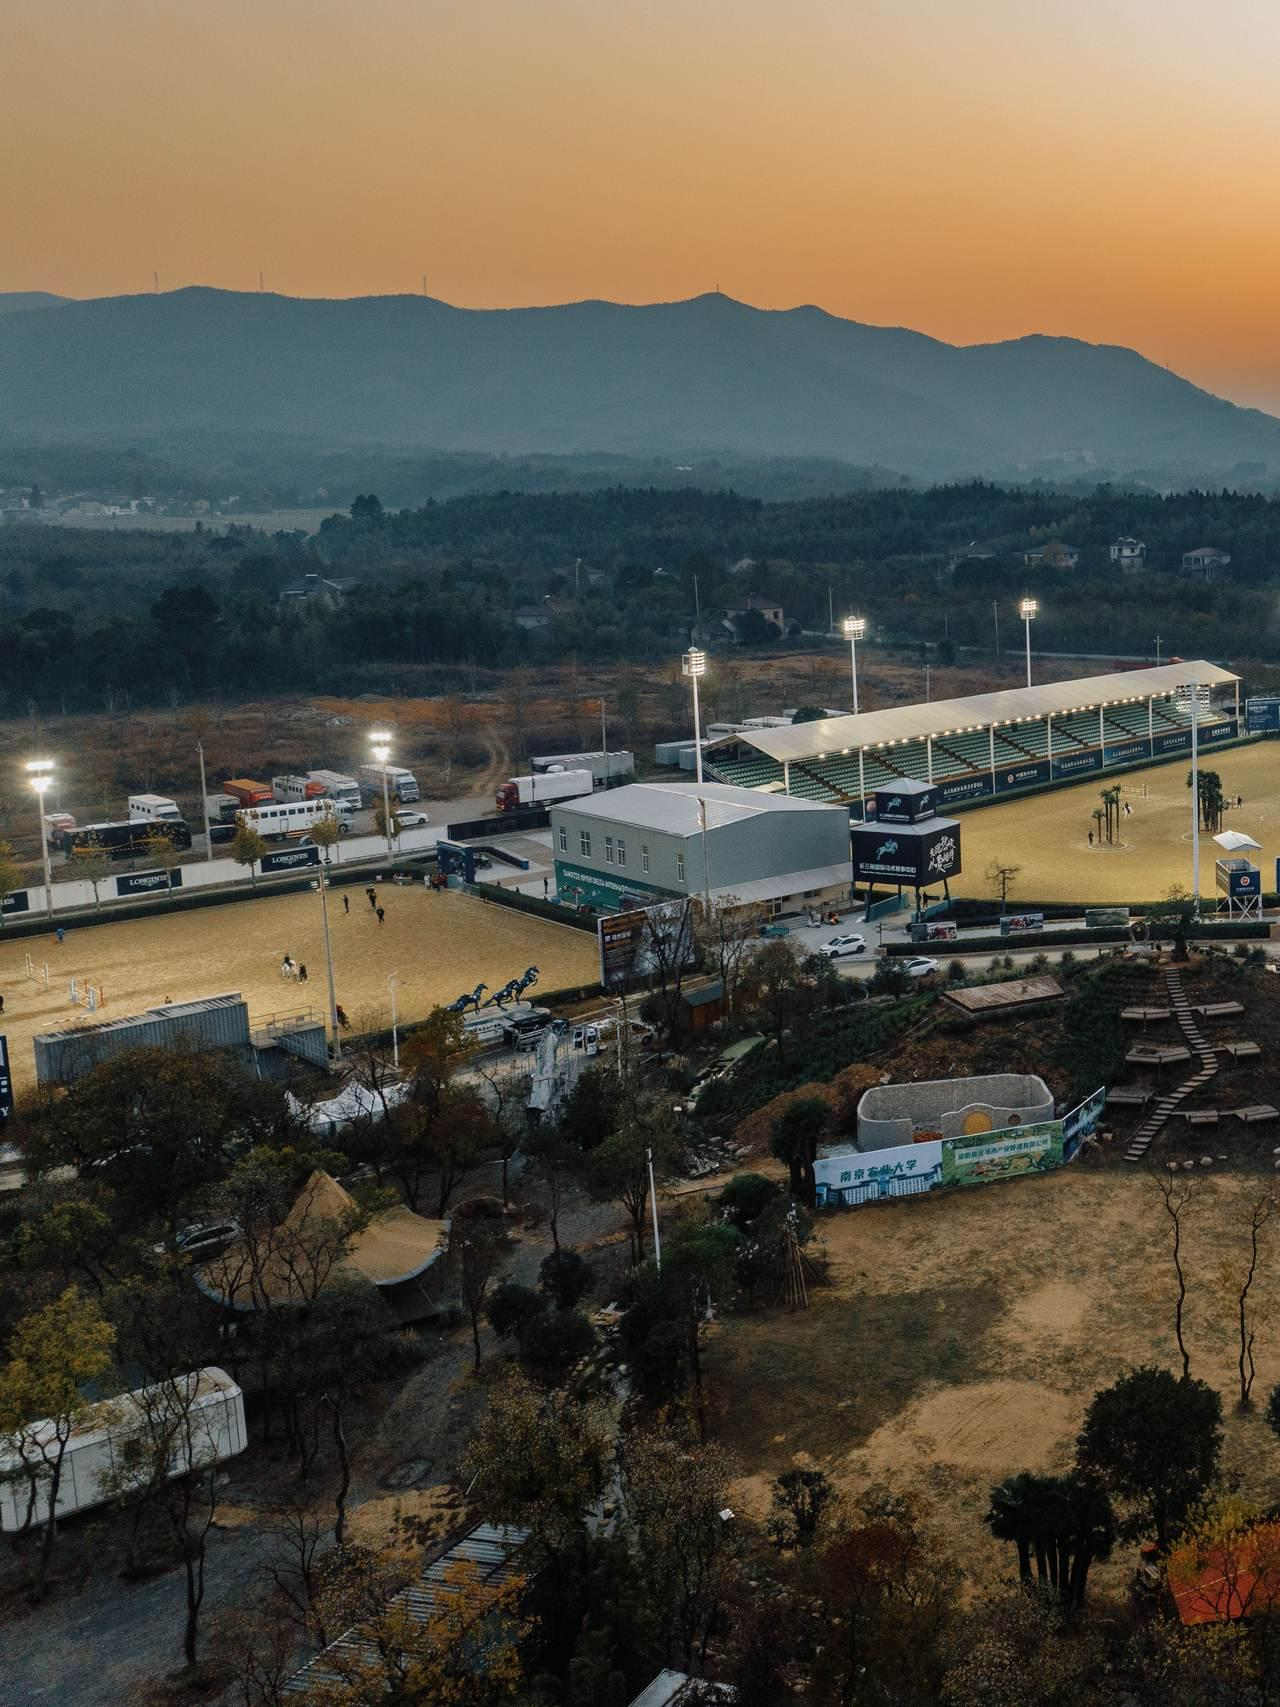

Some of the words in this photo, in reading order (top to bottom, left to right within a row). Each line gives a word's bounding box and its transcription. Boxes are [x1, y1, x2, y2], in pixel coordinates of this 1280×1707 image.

[272, 852, 309, 864] LONGINES
[129, 873, 168, 886] LONGINES
[840, 1159, 917, 1183] 南京农业大学
